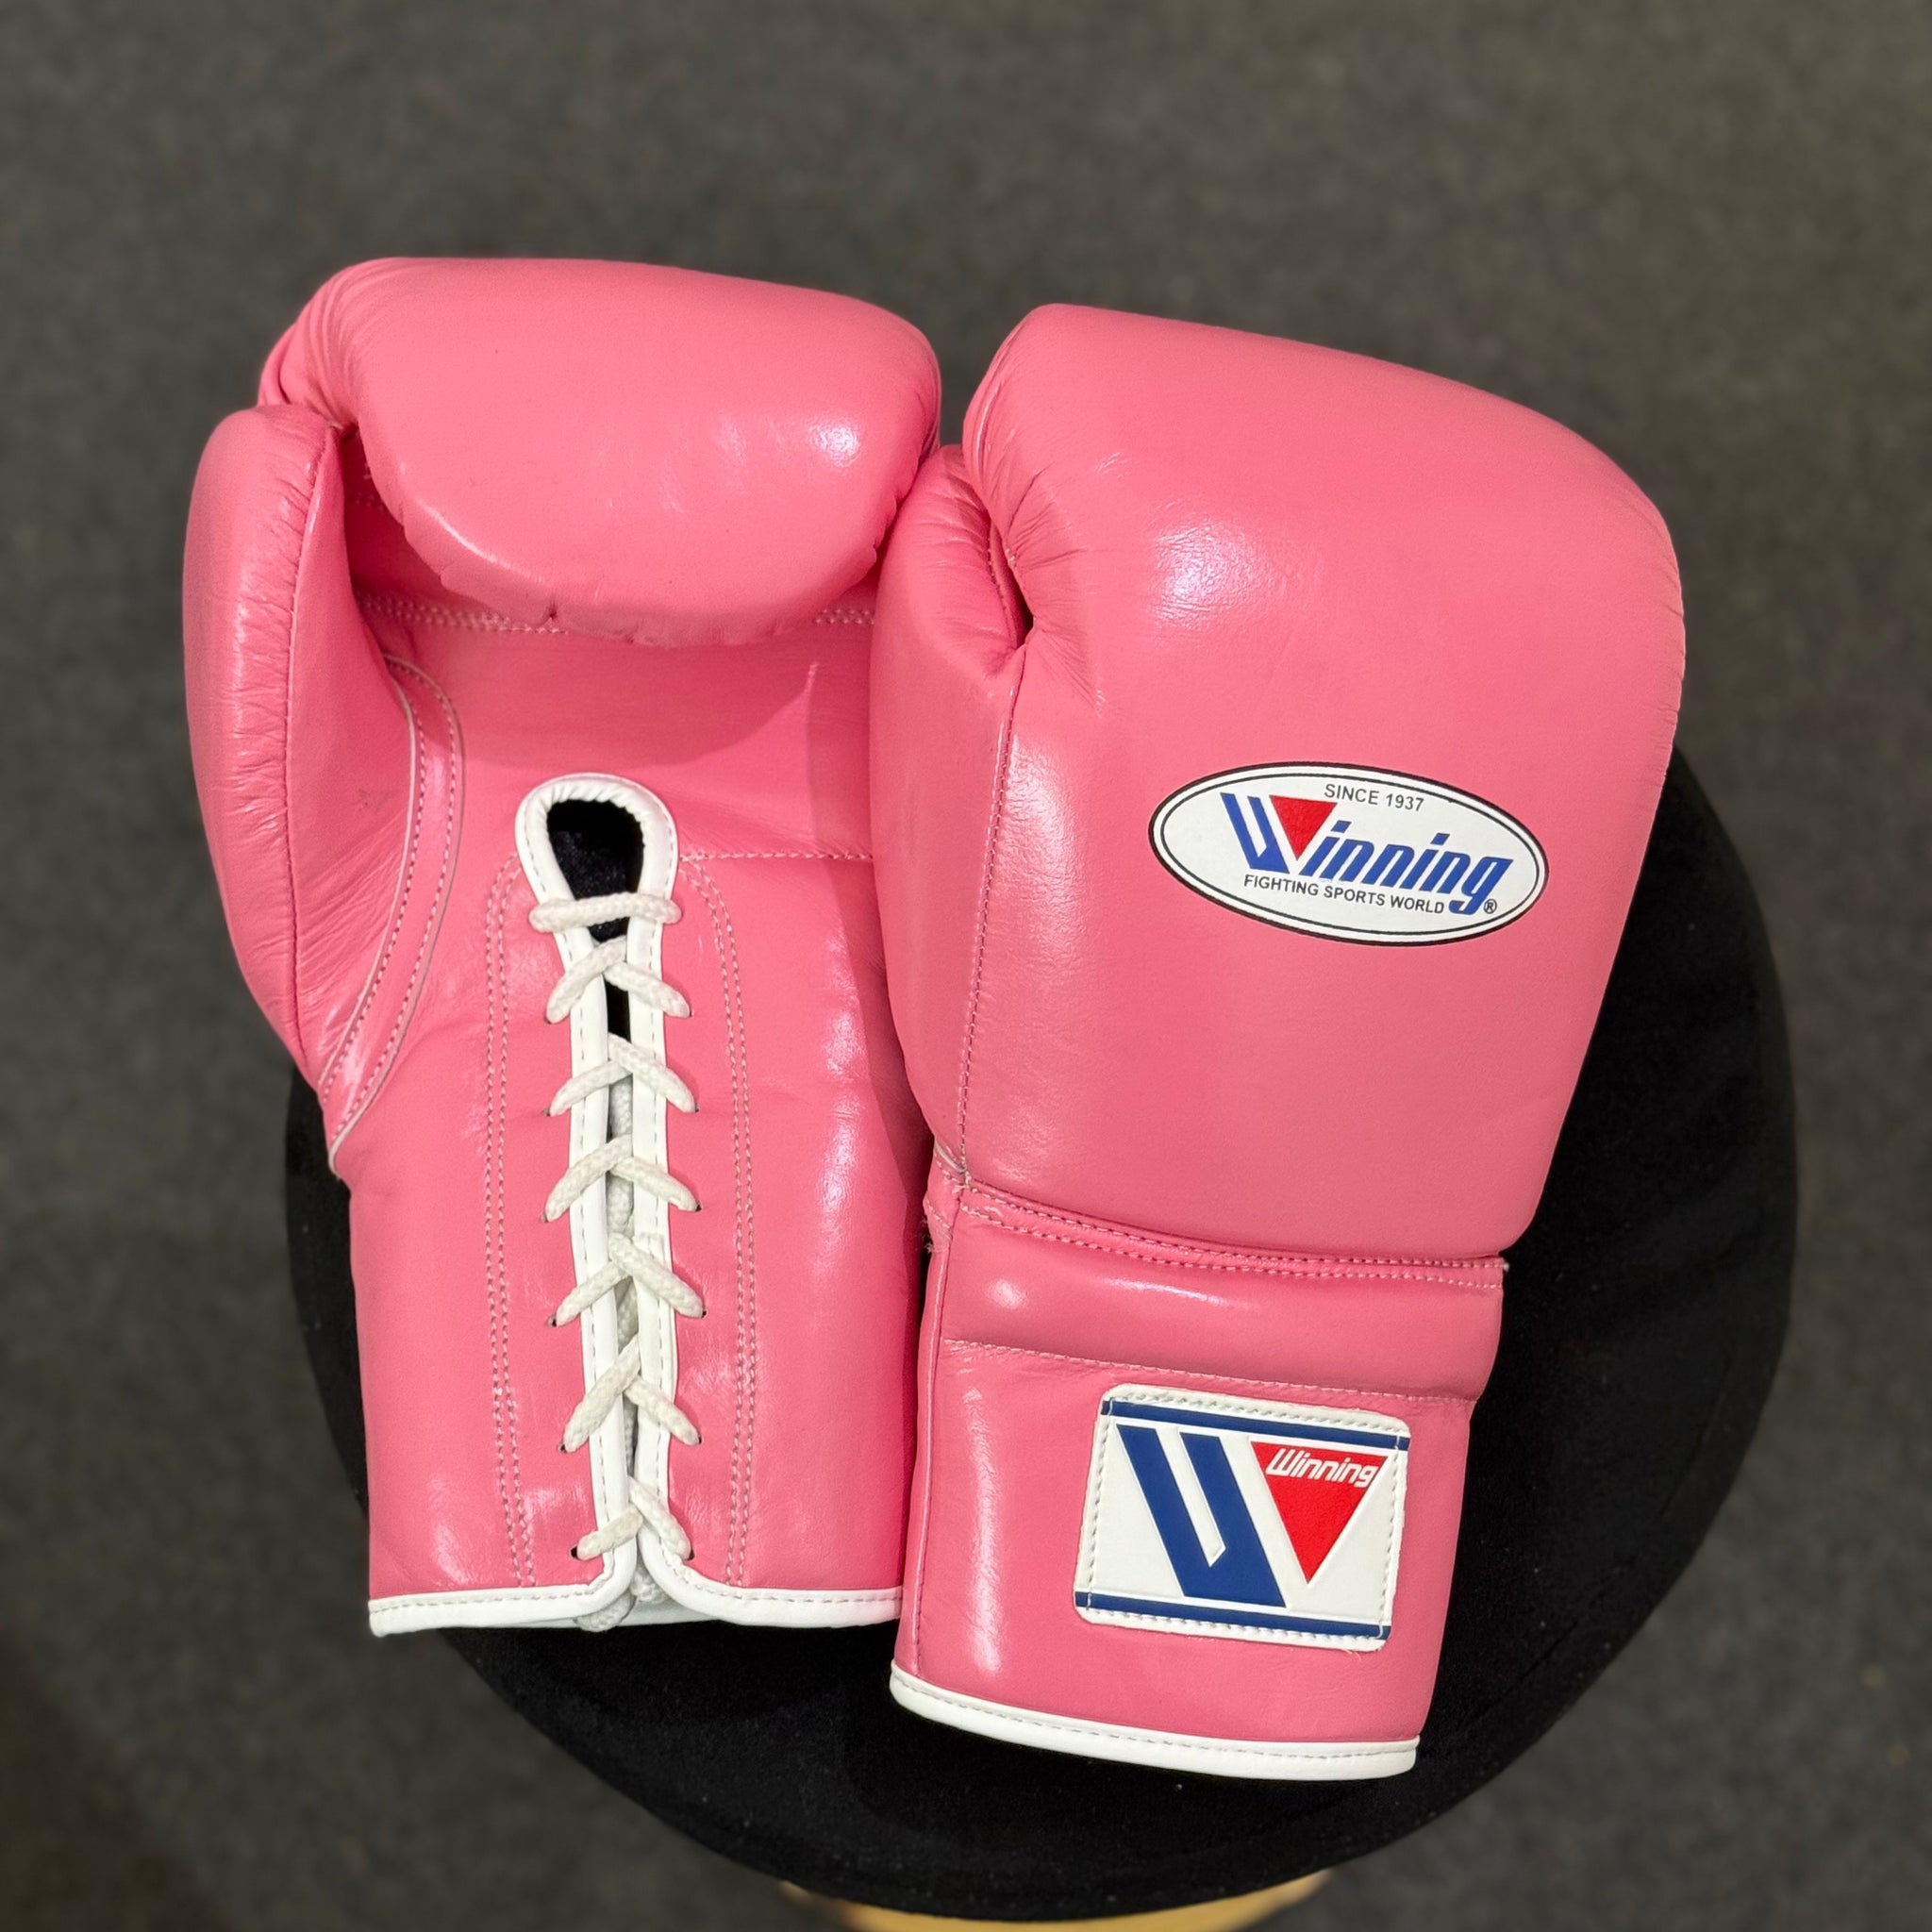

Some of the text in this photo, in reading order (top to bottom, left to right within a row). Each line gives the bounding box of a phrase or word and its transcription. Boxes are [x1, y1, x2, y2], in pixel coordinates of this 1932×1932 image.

[1324, 783, 1424, 812] SINCE 1937
[1220, 791, 1514, 916] Winning
[1243, 874, 1444, 915] FIGHTING SPORTS WORLD
[1265, 1448, 1379, 1488] Winning
